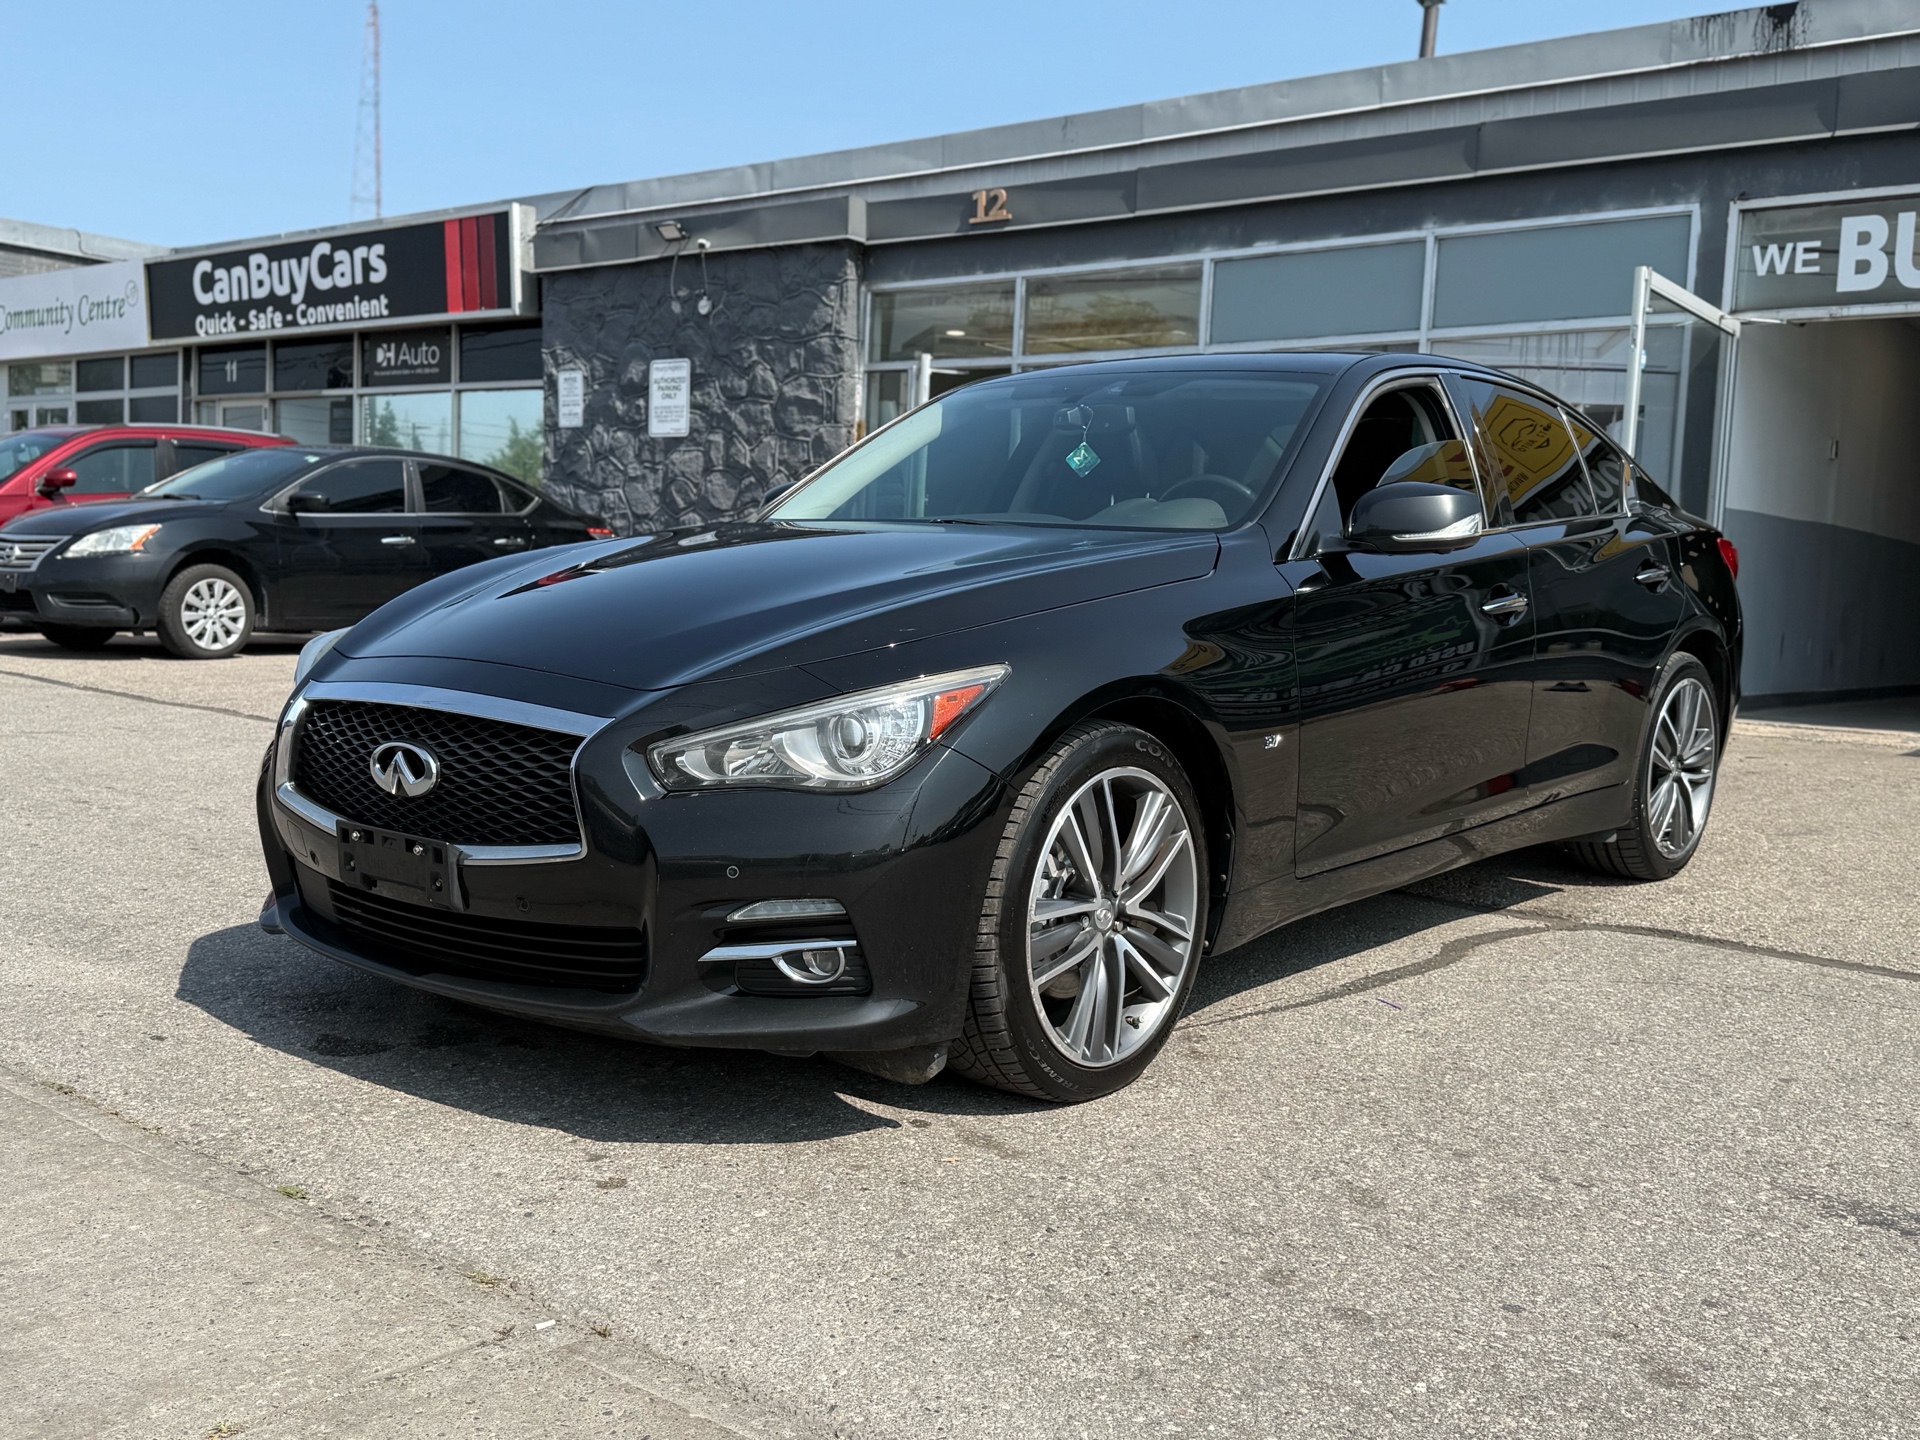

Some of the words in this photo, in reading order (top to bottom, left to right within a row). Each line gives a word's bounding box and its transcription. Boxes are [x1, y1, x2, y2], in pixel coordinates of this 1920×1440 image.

[970, 188, 1011, 221] 12
[1752, 240, 1822, 276] WE
[192, 241, 388, 305] CanBuyCars
[78, 294, 126, 326] Centre
[195, 310, 237, 338] Quick
[248, 305, 283, 331] Safe
[296, 294, 389, 326] Convenient
[397, 342, 440, 366] Auto
[225, 360, 237, 382] 11
[654, 376, 686, 384] AUTHORIZED
[657, 384, 682, 392] PARKING
[661, 392, 677, 400] ONLY
